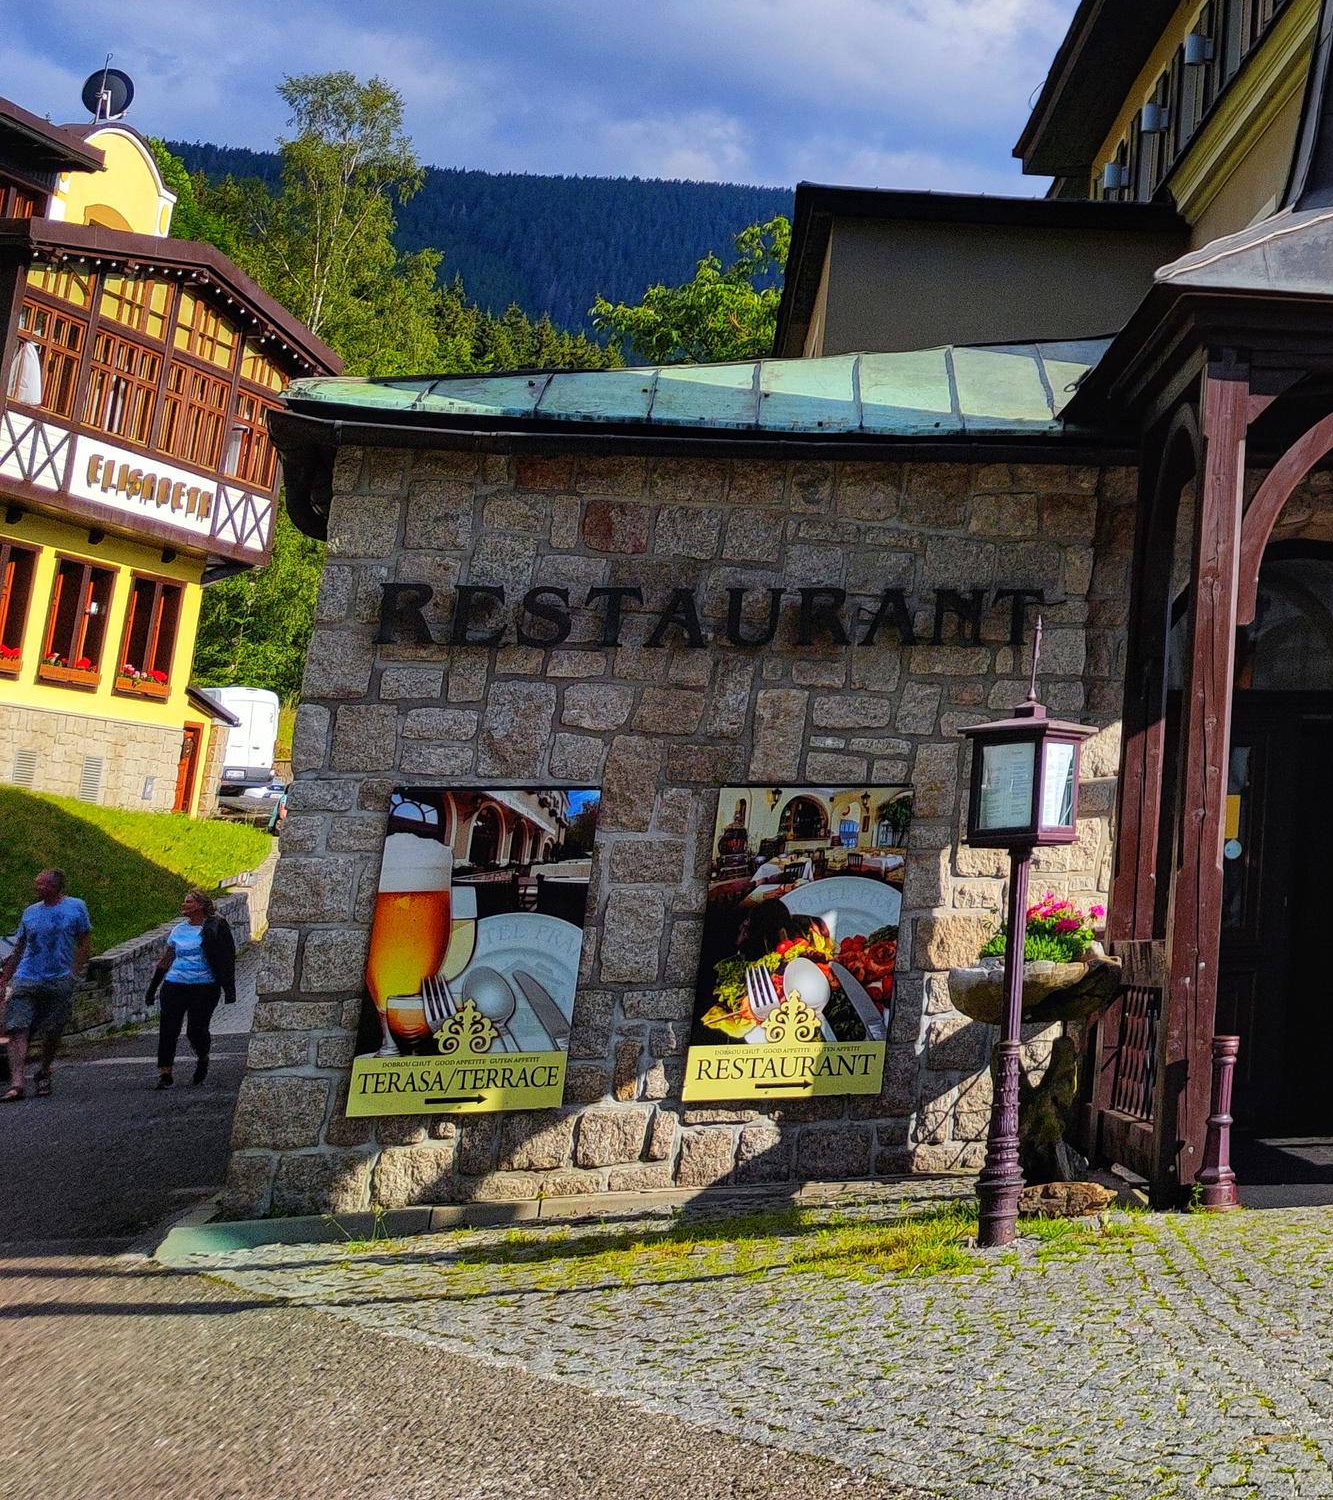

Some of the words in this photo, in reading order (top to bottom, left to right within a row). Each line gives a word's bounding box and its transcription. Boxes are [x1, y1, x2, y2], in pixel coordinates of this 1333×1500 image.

[86, 453, 213, 523] ELISABETH
[371, 581, 1044, 649] RESTAURANT
[382, 1060, 411, 1068] DOBROU
[434, 1058, 455, 1066] GOOD
[489, 1057, 513, 1065] GUTEN
[763, 1047, 783, 1055] GOOD
[358, 1065, 560, 1095] TERASA/TERRACE
[695, 1053, 877, 1081] RESTAURANT
